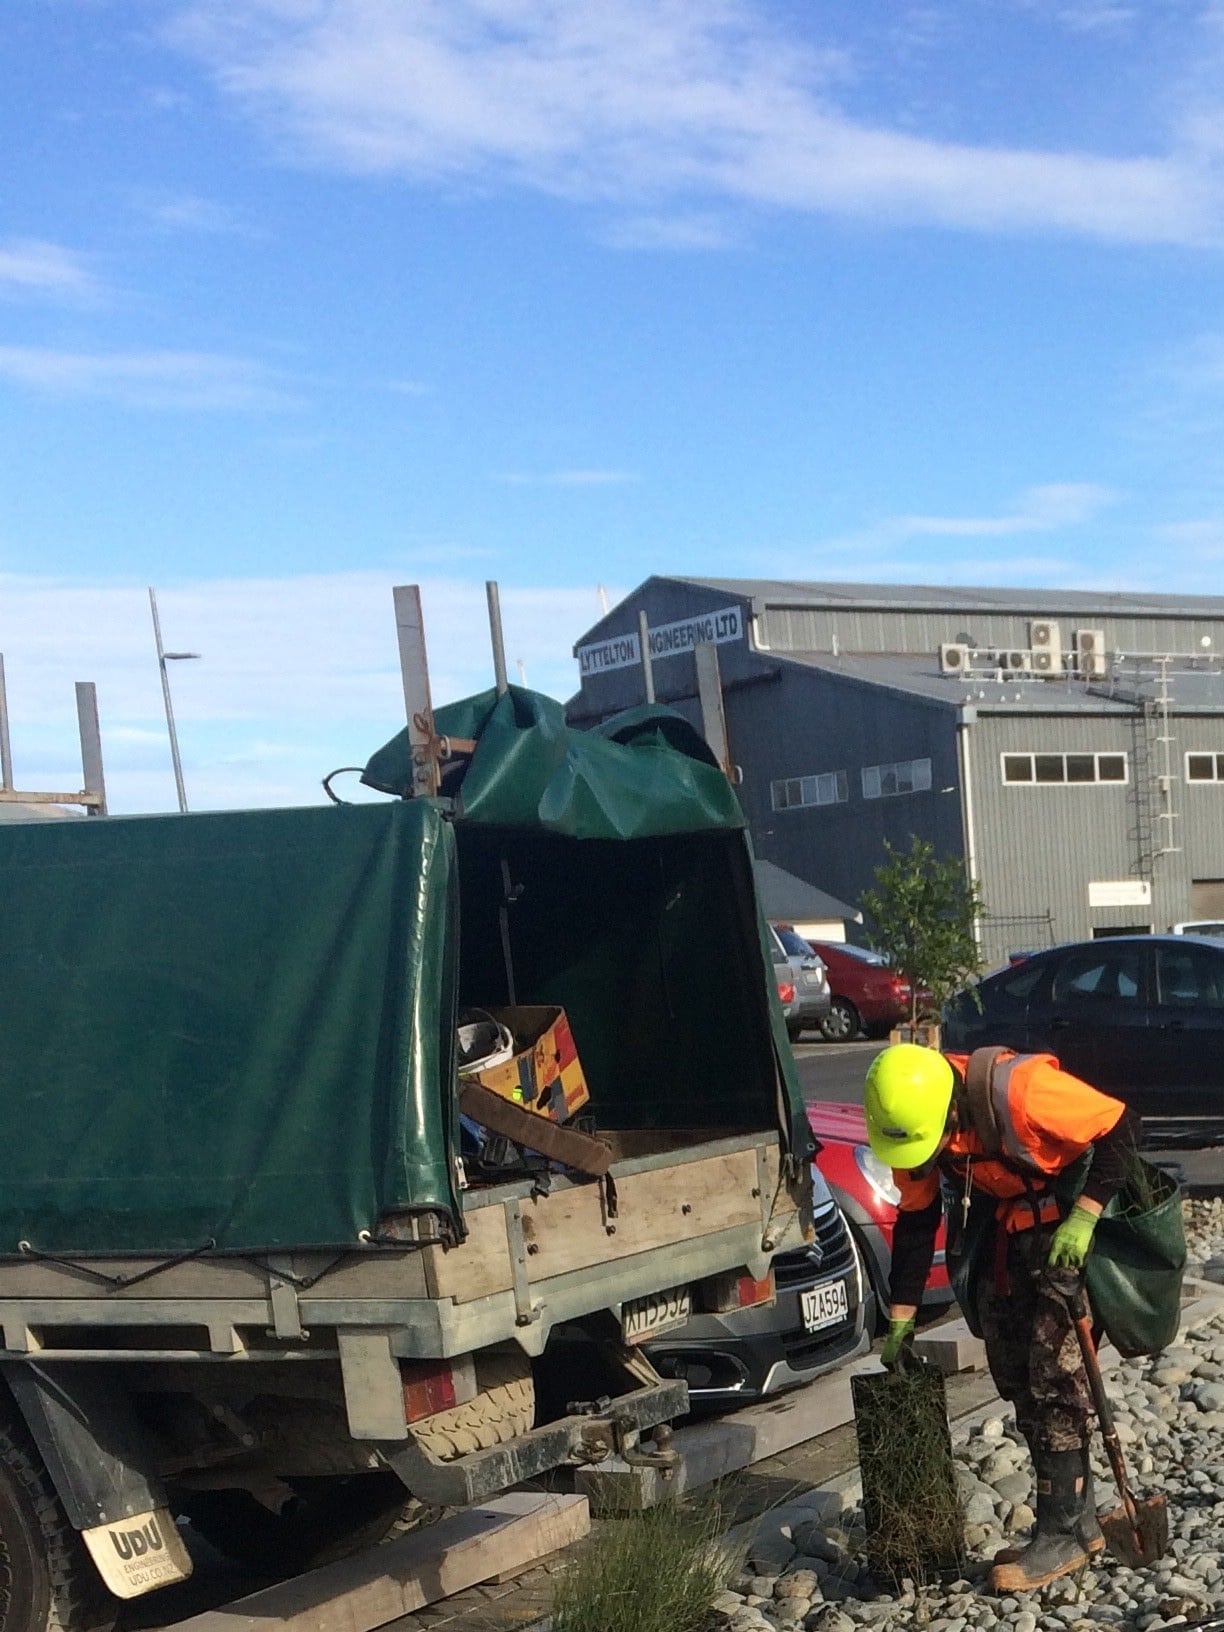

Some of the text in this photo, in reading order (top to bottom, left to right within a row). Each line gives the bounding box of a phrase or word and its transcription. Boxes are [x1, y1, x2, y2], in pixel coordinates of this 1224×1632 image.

[581, 612, 738, 671] LYTTELTON NGINEERING LTD
[804, 1286, 846, 1324] JZA594
[109, 1518, 163, 1560] UDU
